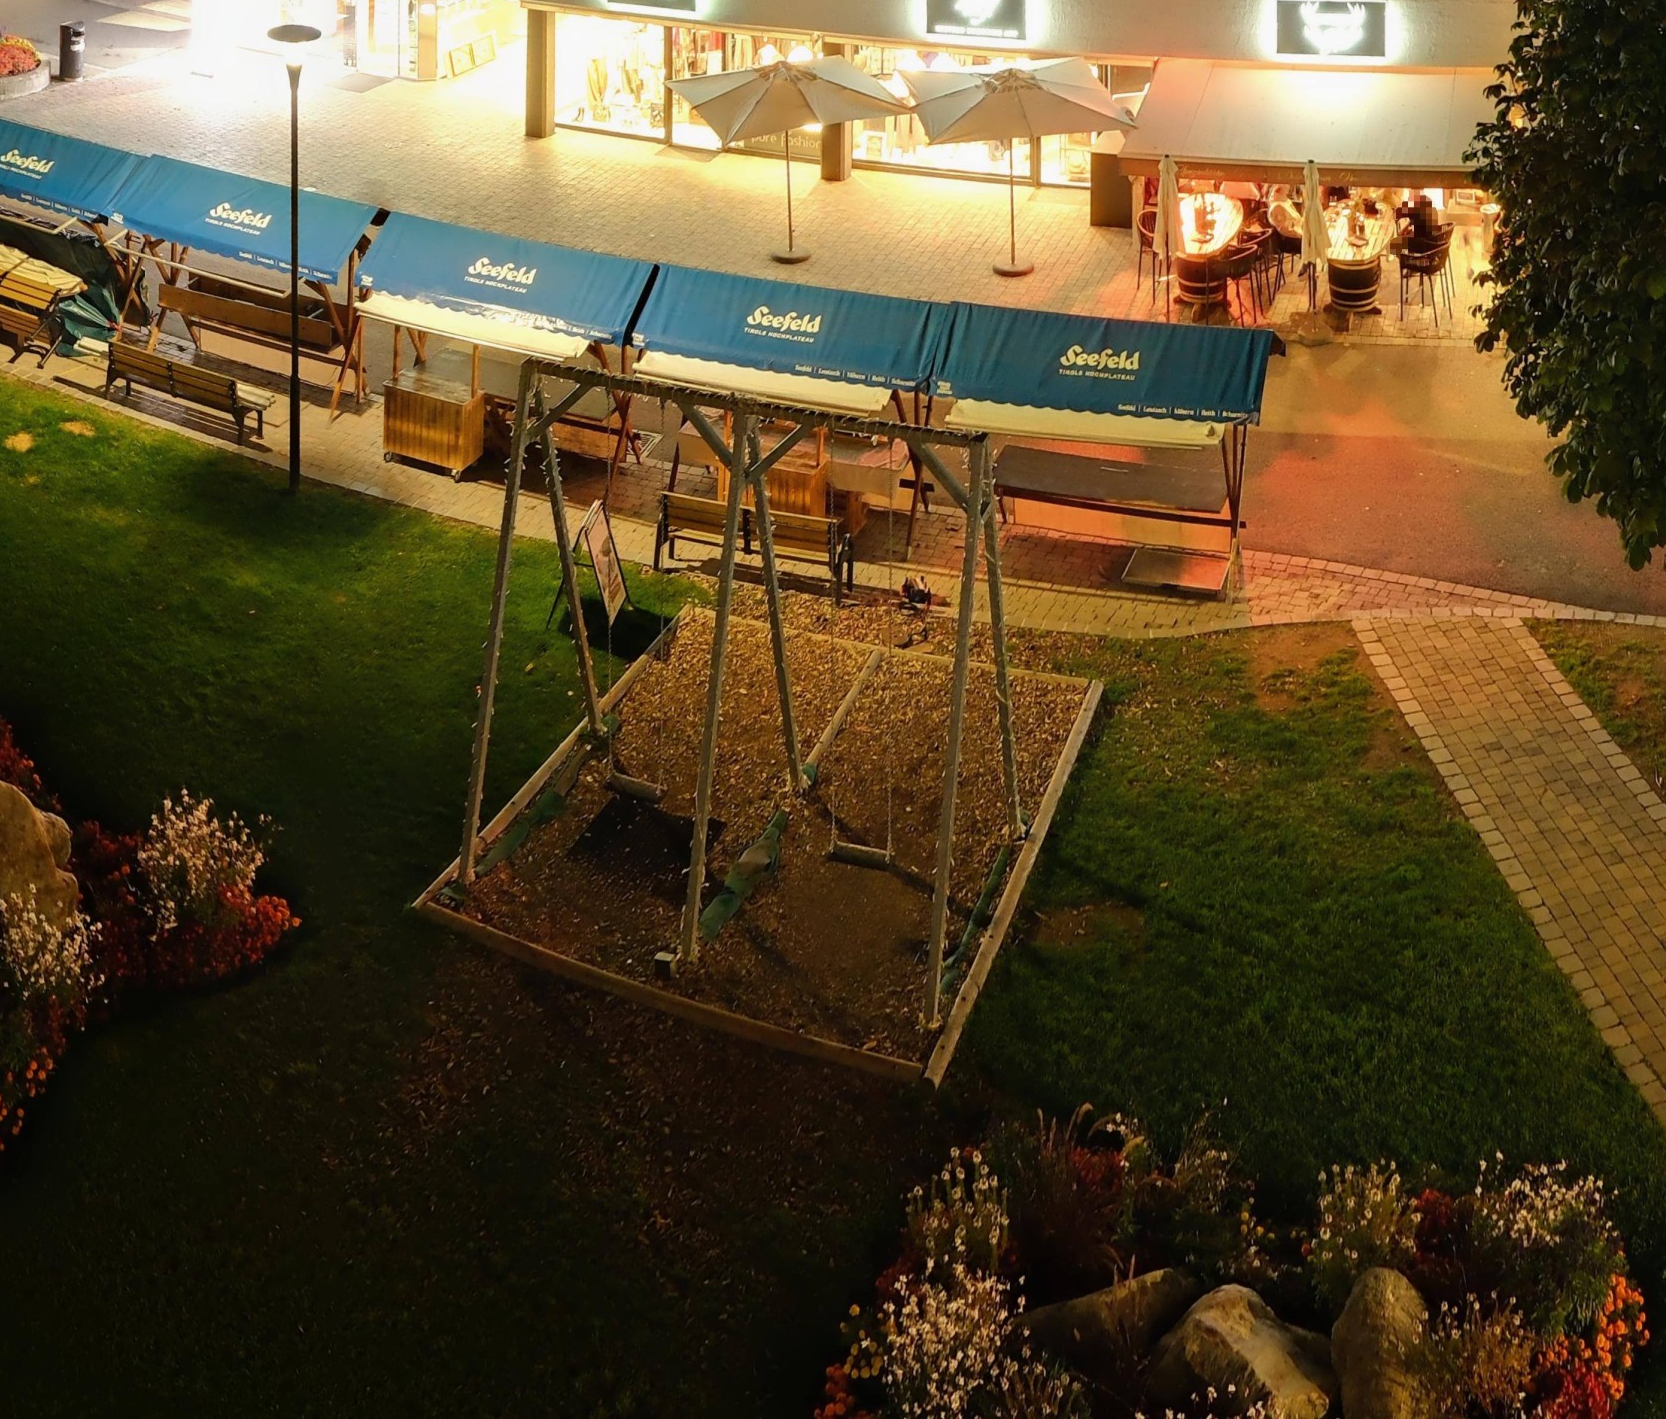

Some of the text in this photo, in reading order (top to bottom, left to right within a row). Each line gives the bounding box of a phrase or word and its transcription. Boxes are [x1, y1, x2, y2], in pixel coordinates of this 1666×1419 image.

[752, 133, 778, 144] pure
[0, 148, 56, 174] Seefeld
[209, 202, 273, 229] Seefeld
[467, 257, 537, 286] Seefeld
[746, 305, 822, 334] Seefeld
[744, 327, 815, 344] TIROLS HOCHPLATEAU
[1059, 344, 1141, 372] Seefeld
[1058, 368, 1136, 381] TIROLS HOCHPLATEAU
